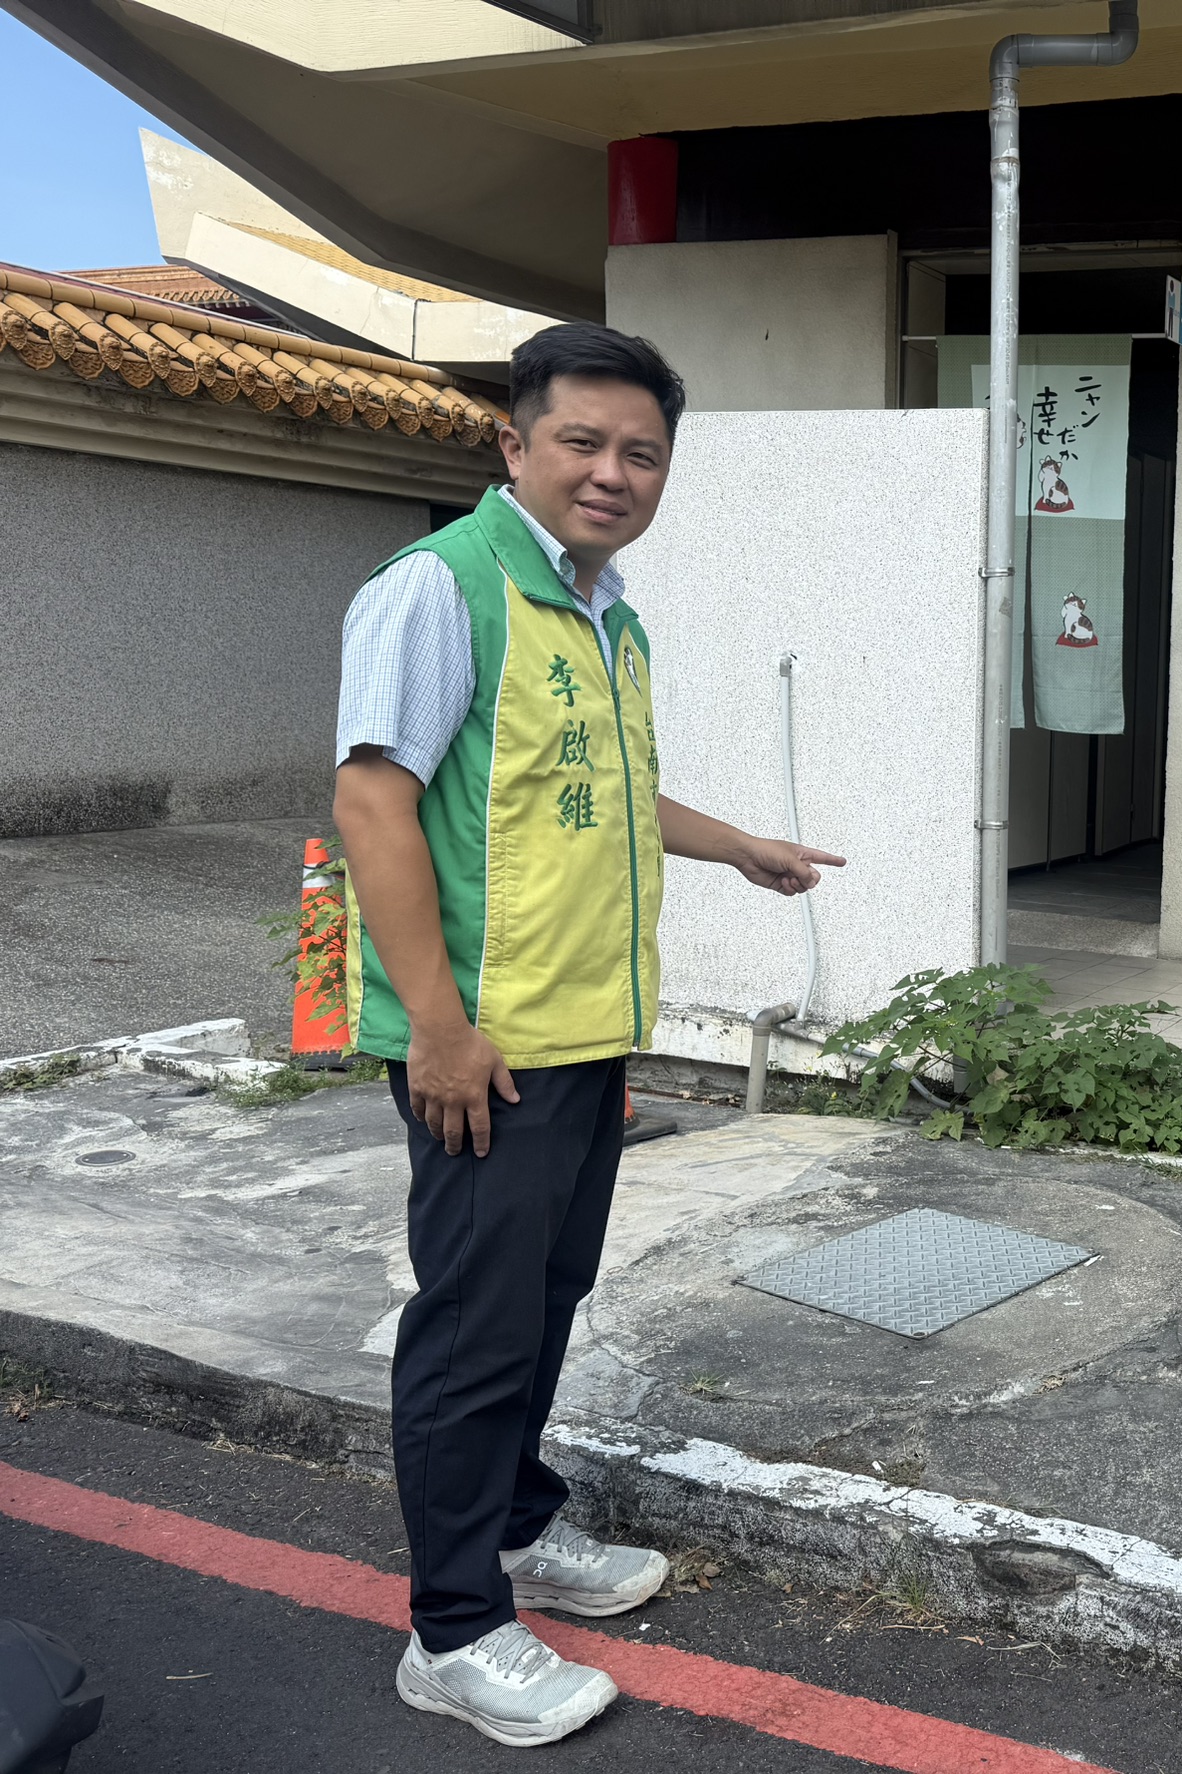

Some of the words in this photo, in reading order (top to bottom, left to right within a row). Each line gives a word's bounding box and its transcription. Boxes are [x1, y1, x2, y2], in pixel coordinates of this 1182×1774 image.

[1033, 386, 1058, 445] 幸せ
[546, 654, 598, 831] 李啟維
